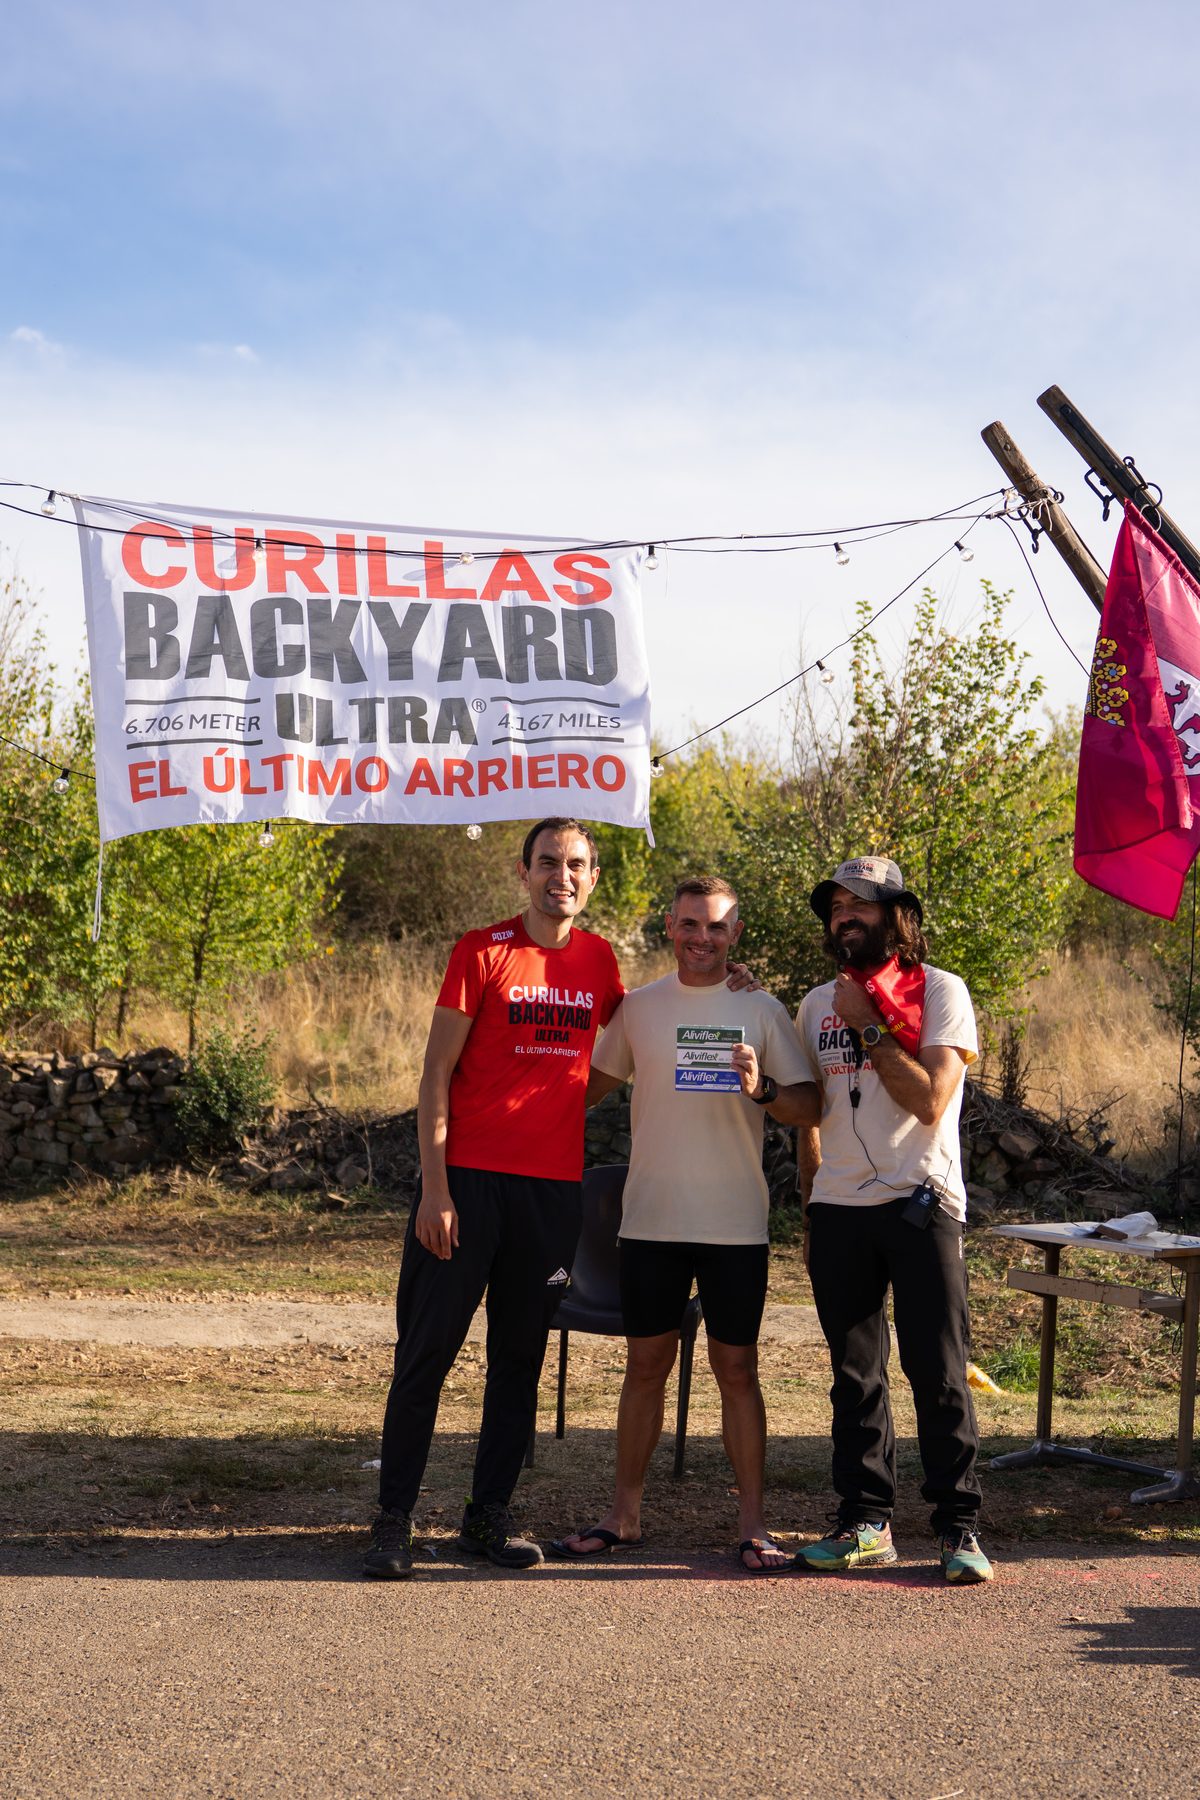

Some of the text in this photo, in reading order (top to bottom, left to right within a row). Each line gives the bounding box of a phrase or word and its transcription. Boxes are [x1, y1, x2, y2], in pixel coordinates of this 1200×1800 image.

[121, 521, 613, 606] CURILLAS
[122, 591, 619, 687] BACKYARD
[124, 713, 261, 736] 6.706 METER
[497, 713, 622, 732] 4.167 MILES
[128, 747, 627, 803] EL ÚLTIMO ARRIERO
[509, 986, 593, 1009] CURILLAS
[509, 1004, 591, 1030] BACKYARD
[535, 1029, 569, 1043] ULTRA
[515, 1045, 525, 1054] EL
